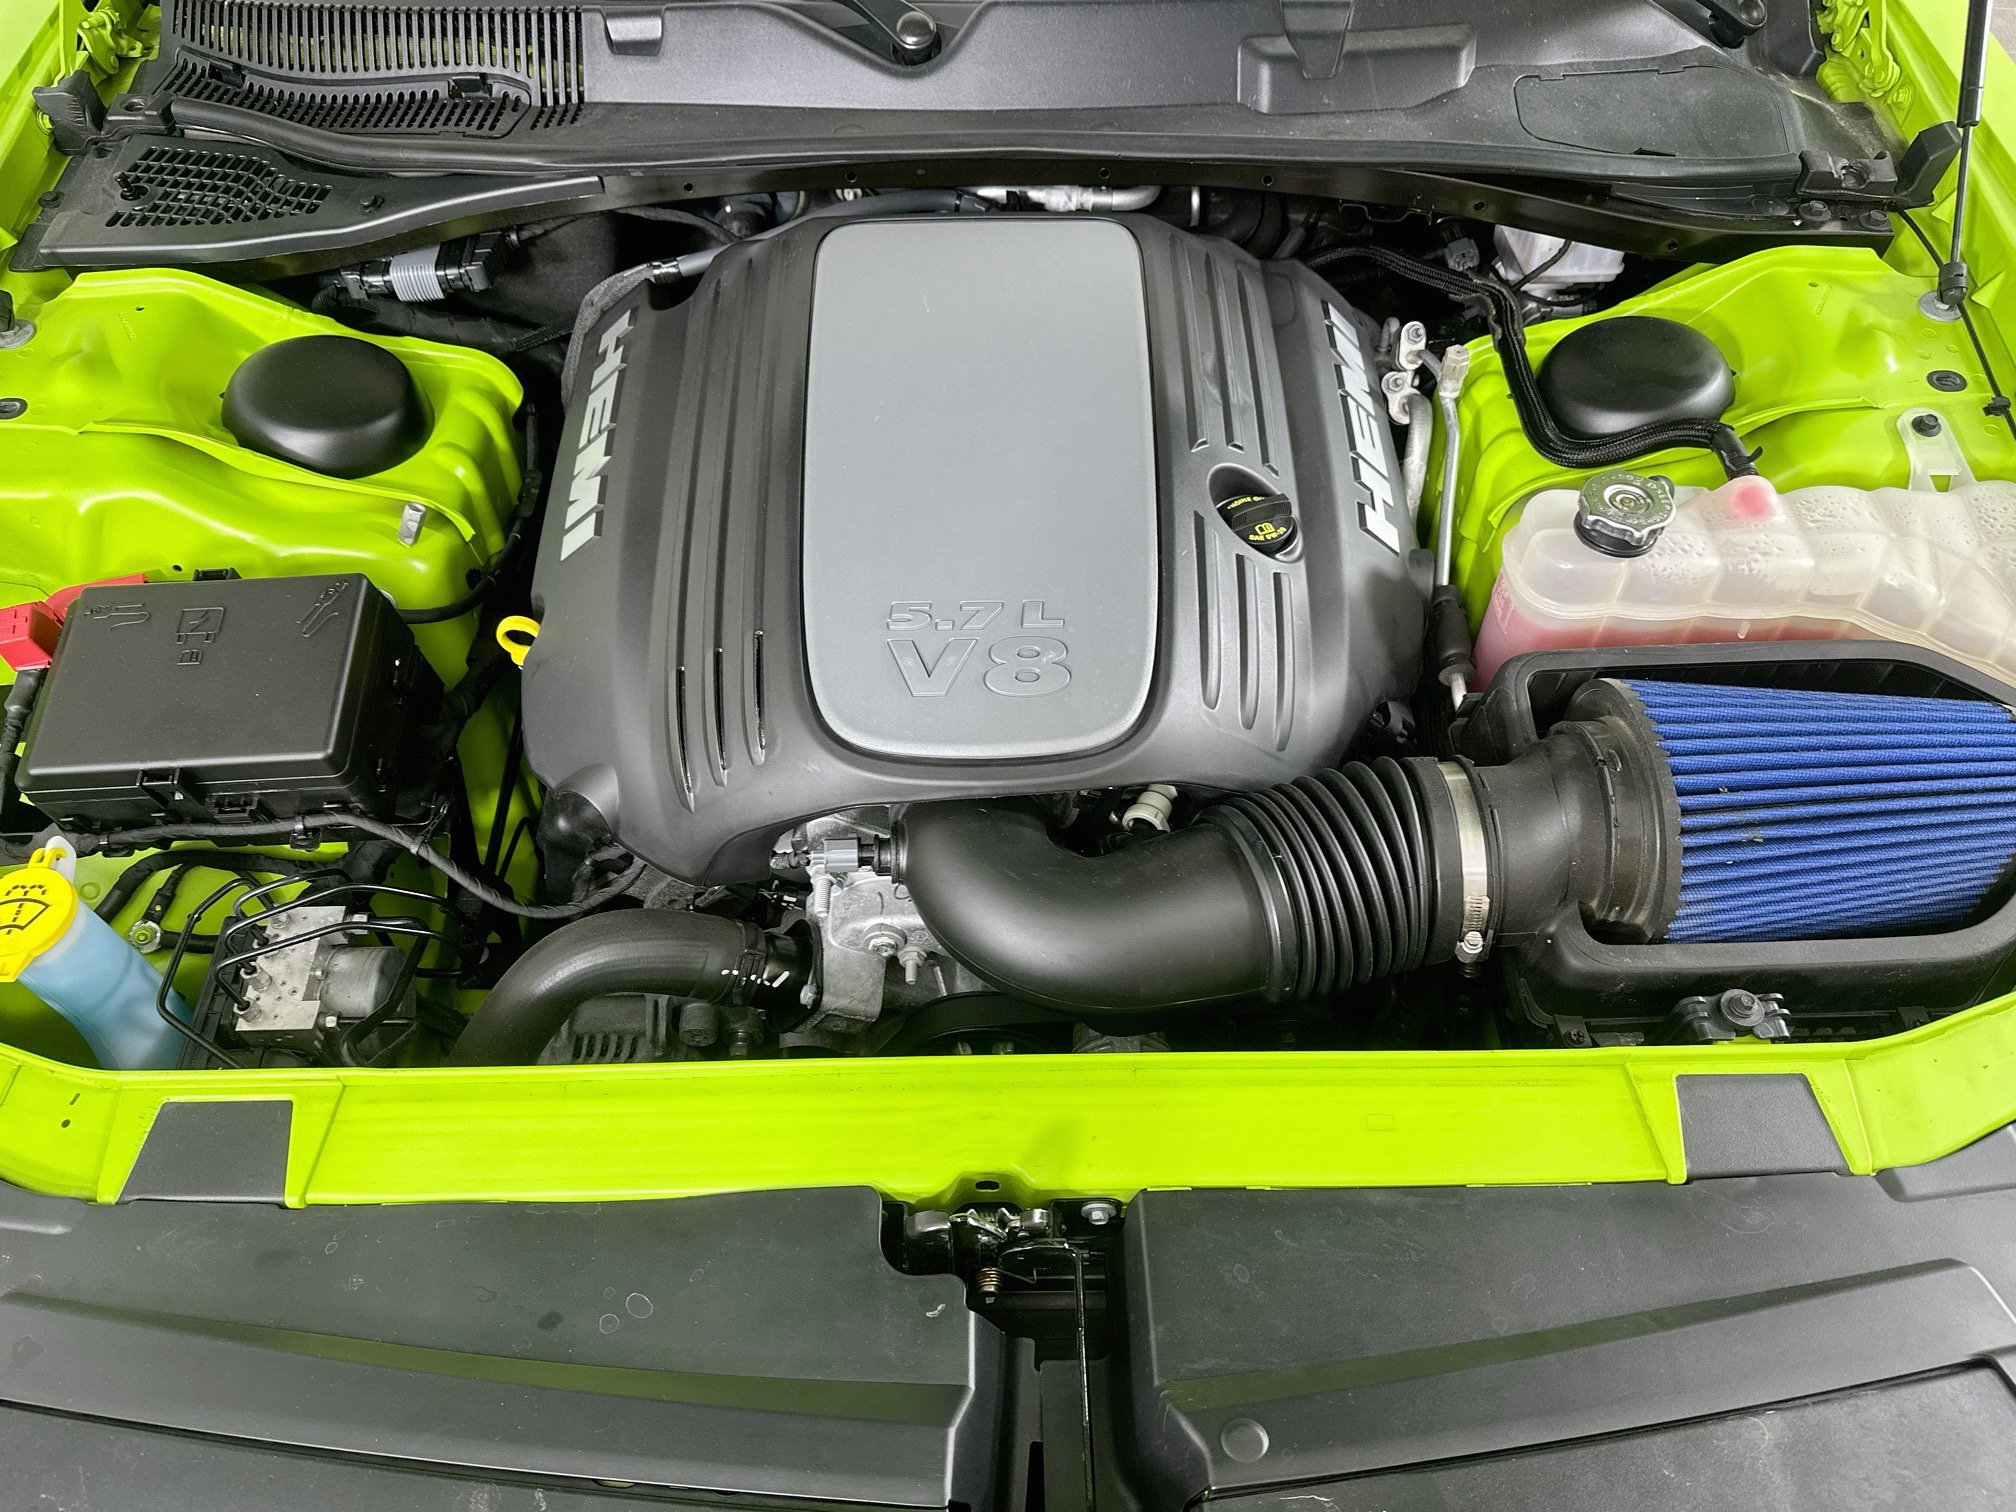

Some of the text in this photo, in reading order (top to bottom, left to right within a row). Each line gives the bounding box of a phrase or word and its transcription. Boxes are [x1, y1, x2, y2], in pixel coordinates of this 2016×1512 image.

[560, 309, 633, 561] HEMI
[1324, 301, 1400, 555] HEMI
[886, 599, 1066, 632] 5.7 L
[886, 635, 1072, 699] V8
